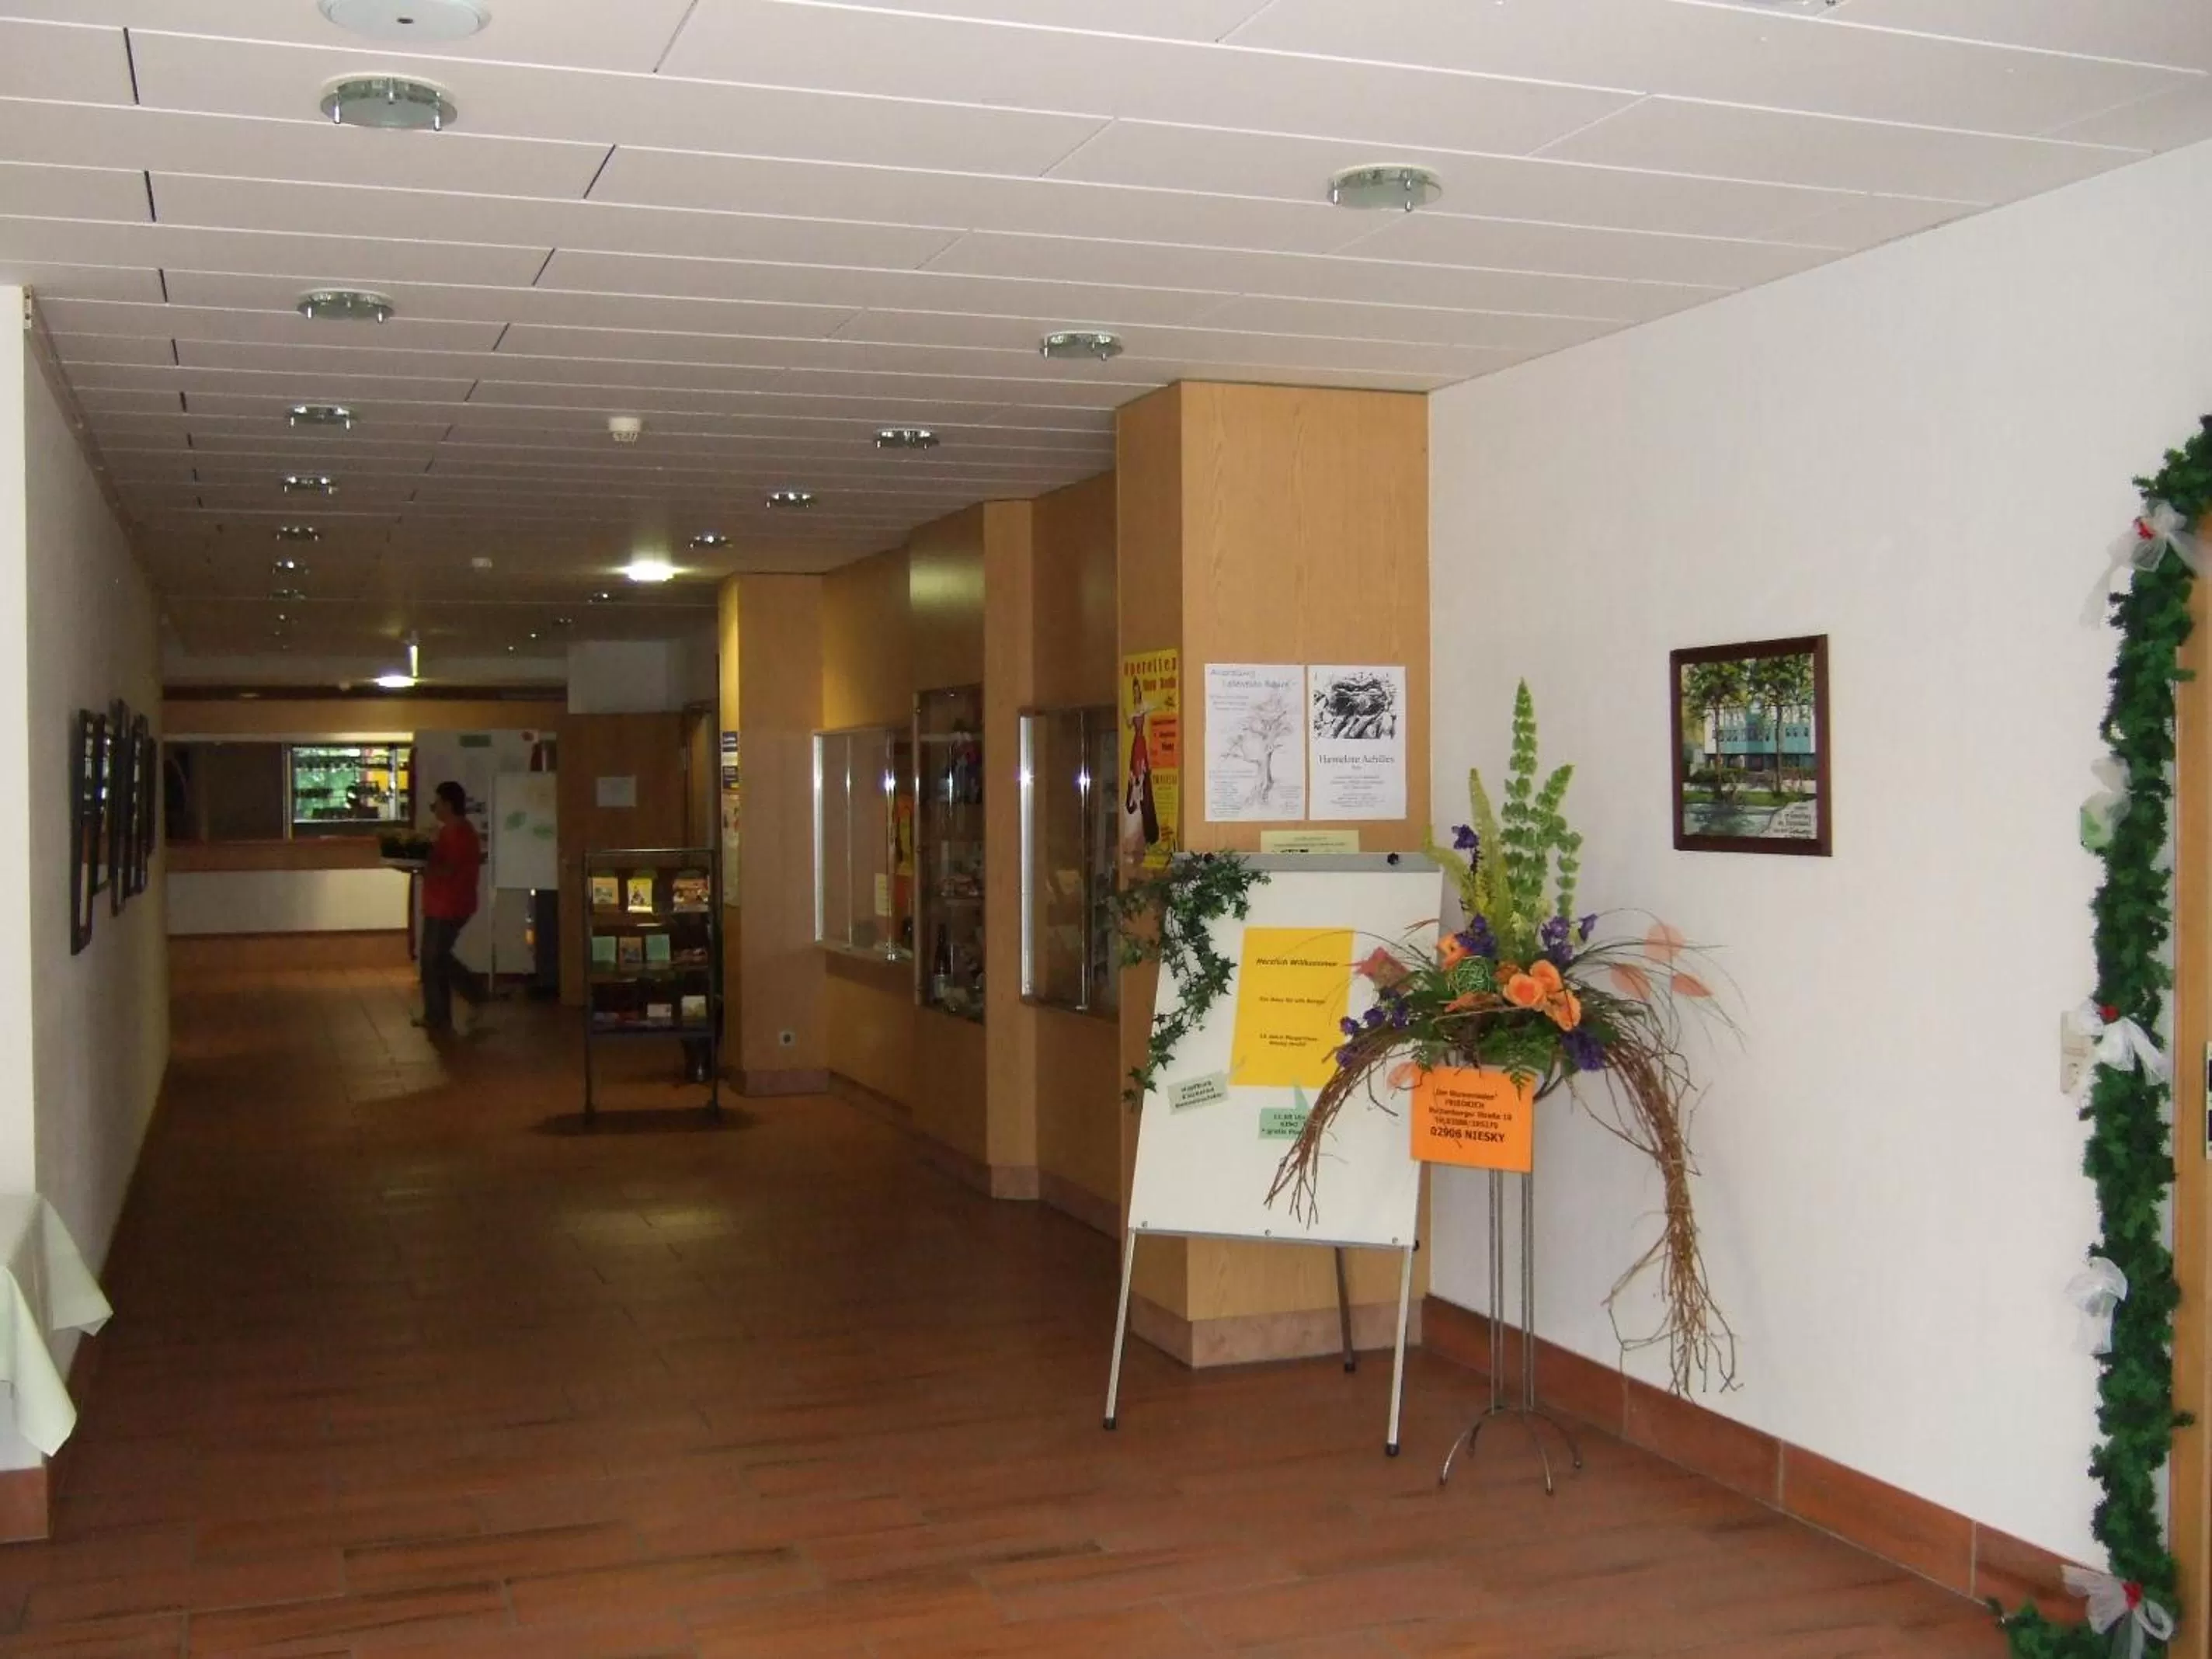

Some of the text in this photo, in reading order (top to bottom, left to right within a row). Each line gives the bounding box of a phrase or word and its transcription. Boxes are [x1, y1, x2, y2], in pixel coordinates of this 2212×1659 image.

[1255, 958, 1288, 966] Herzlich
[1430, 1126, 1504, 1143] 02906 NIESKY
